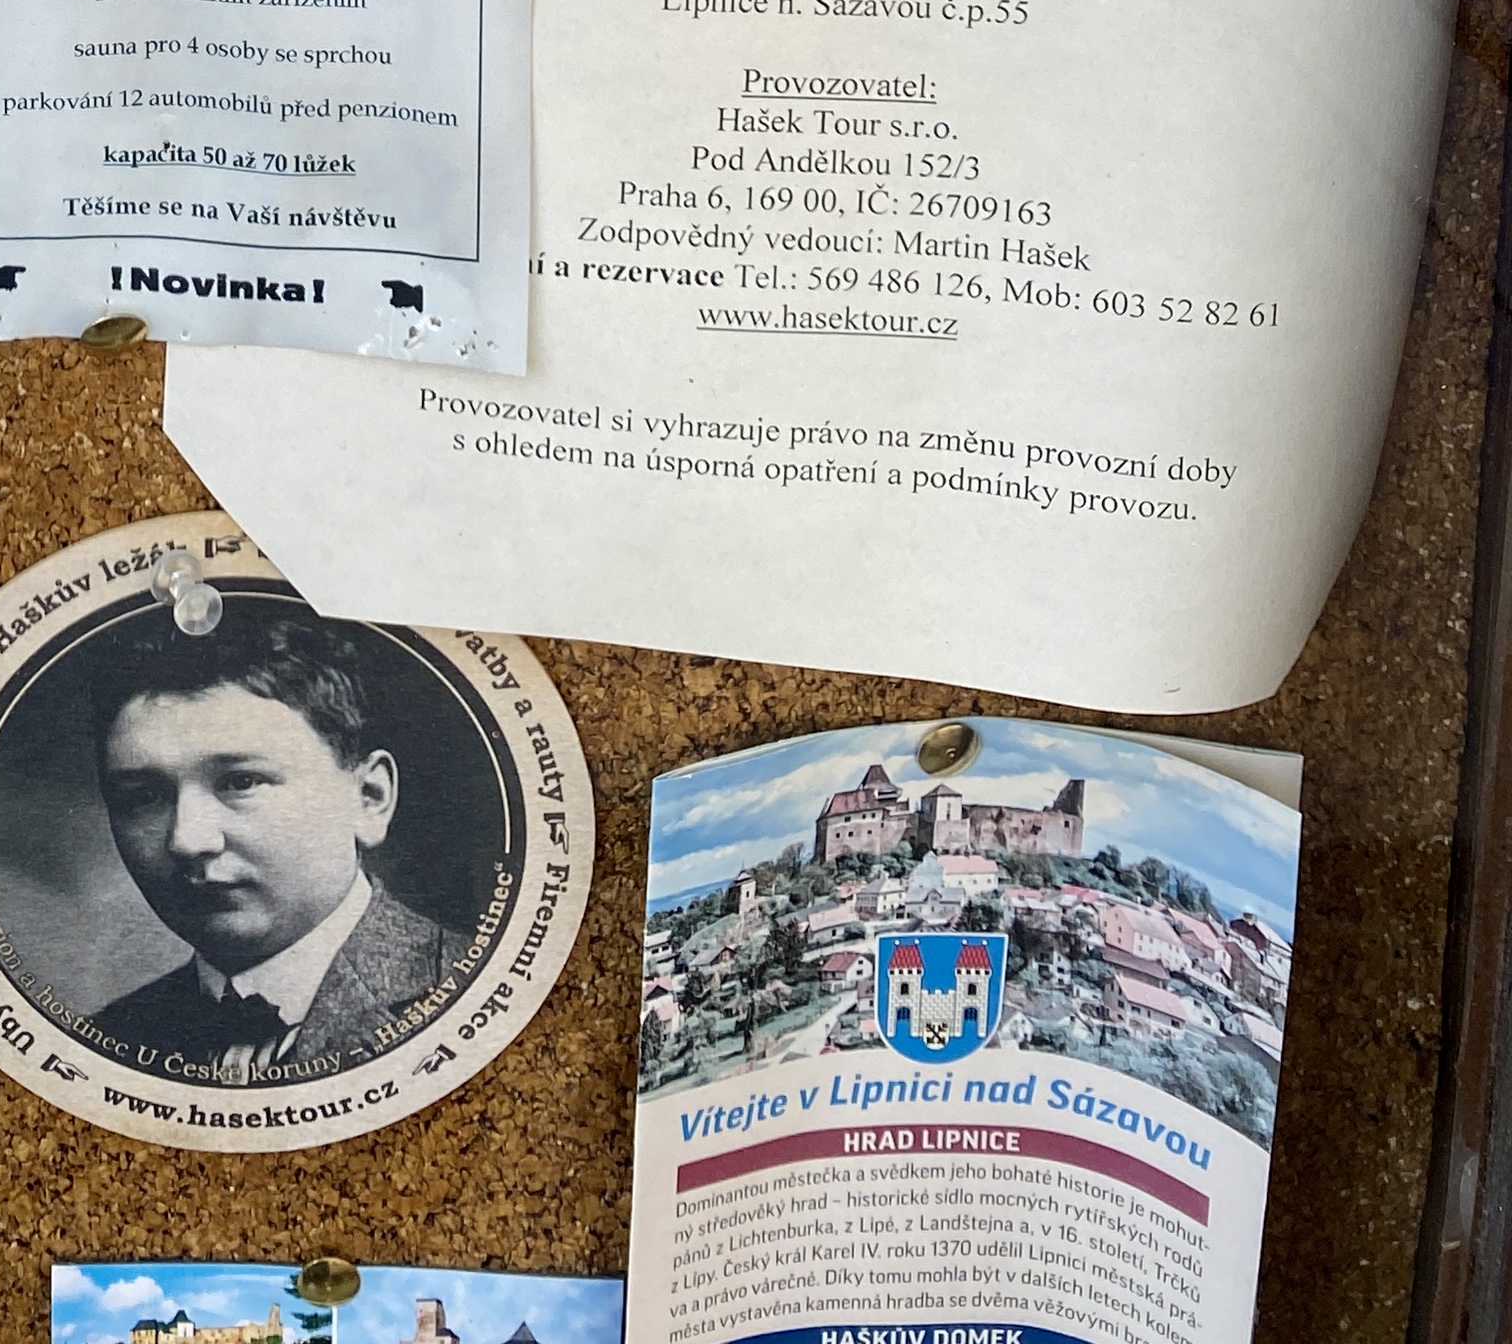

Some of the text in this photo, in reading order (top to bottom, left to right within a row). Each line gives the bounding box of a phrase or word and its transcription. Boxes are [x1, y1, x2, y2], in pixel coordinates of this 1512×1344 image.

[74, 37, 392, 69] sauna pro 4 osoby se sprchou
[743, 69, 937, 104] Provozovatel:
[716, 107, 959, 141] Hašek Tour s.r.o.
[103, 142, 356, 175] kapacita 50 až 70 lůžek
[691, 145, 981, 183] Pod Andělkou 152/3
[63, 195, 397, 230] Těšíme se na Vaší návštěvu
[618, 181, 1052, 228] Praha 6, 169 00, IČ: 26709163
[577, 216, 1091, 272] Zodpovědný vedoucí: Martin Hašek
[553, 261, 571, 279] a
[581, 261, 725, 288] rezervace
[733, 263, 798, 291] Tel.:
[807, 266, 859, 293] 569
[868, 268, 921, 295] 486
[933, 271, 992, 302] 126,
[1002, 276, 1082, 311] Mob:
[1091, 288, 1147, 318] 603
[1158, 296, 1195, 323] 52
[1204, 300, 1240, 325] 82
[1248, 301, 1281, 328] 61
[697, 306, 959, 340] www.hasektour.cz
[458, 861, 570, 1044] Firemní akce
[102, 1079, 399, 1129] www.hasektour.cz
[679, 1073, 1213, 1171] Vítejte v Lipnici nad Sázavou
[842, 1130, 1021, 1155] HRAD LIPNICE
